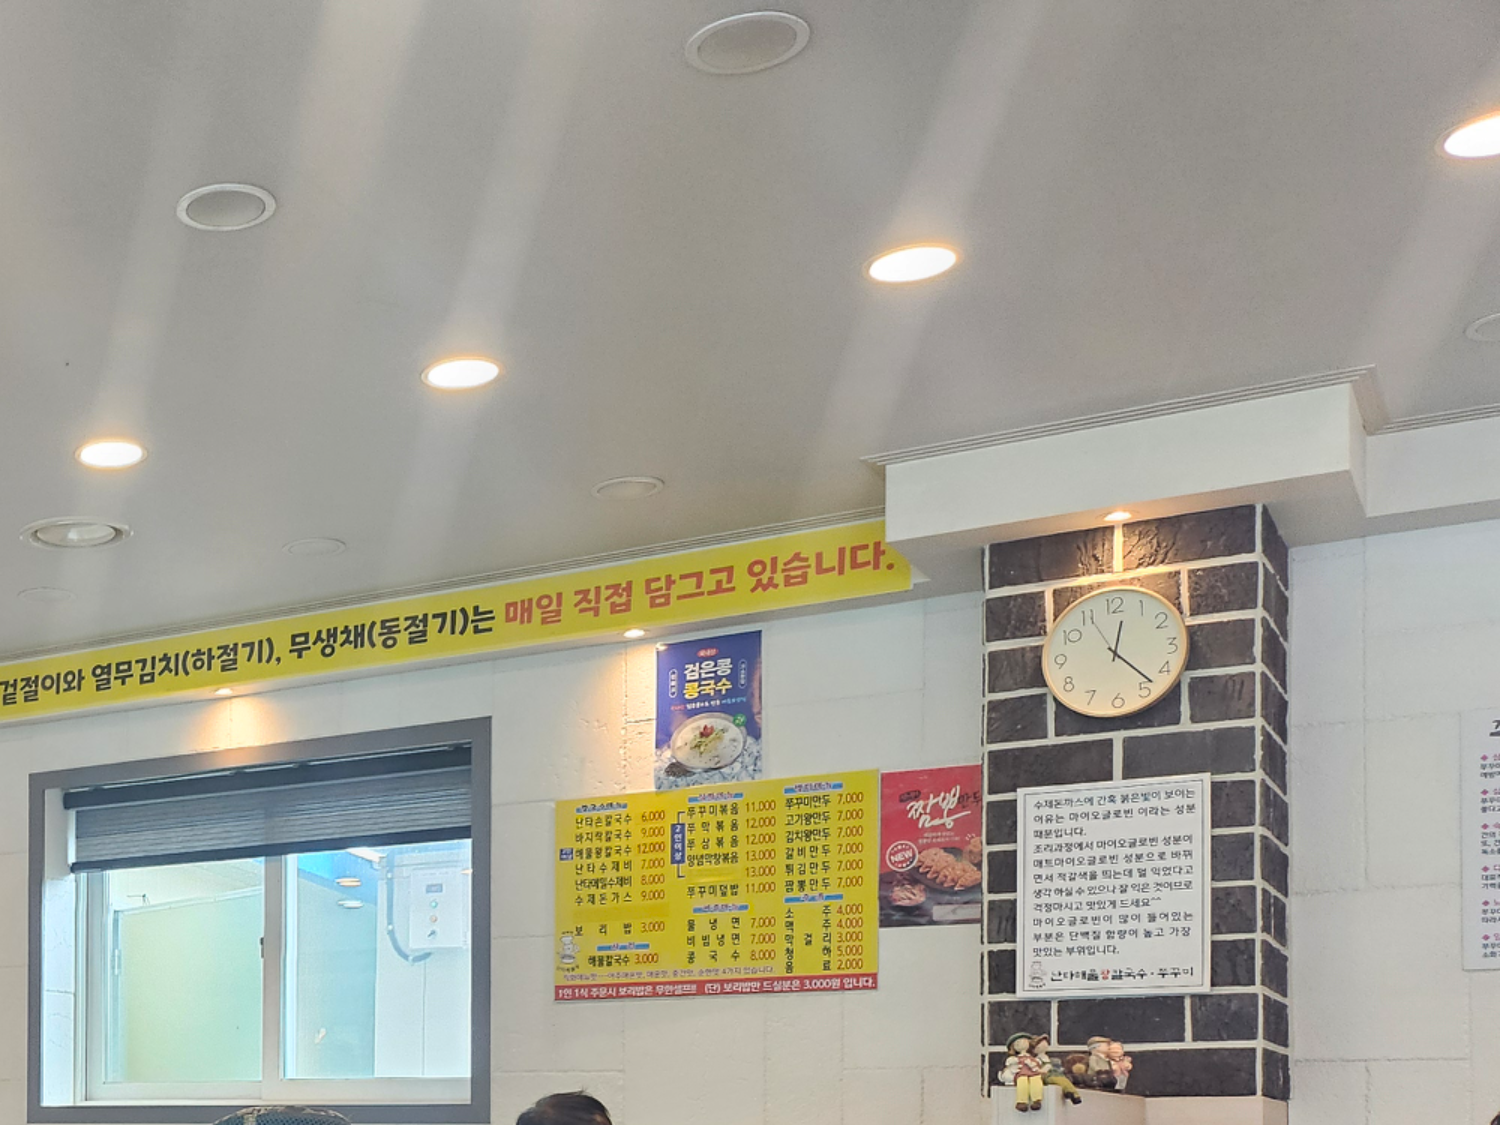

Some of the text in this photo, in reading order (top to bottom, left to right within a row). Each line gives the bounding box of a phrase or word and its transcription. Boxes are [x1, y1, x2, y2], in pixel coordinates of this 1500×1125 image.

[1105, 596, 1125, 615] 12
[90, 636, 282, 692] 열무김치(하절기),
[289, 604, 496, 659] 무생채(동절기)는
[504, 592, 564, 626] 매일
[573, 580, 634, 618] 직접
[643, 565, 736, 609] 담그고
[746, 540, 895, 594] 있습니다.
[1154, 612, 1168, 630] 2
[1062, 628, 1082, 646] 10
[1166, 637, 1178, 654] 3
[684, 658, 733, 681] 검은콩
[1054, 653, 1067, 669] 9
[1158, 660, 1171, 676] 4
[683, 677, 733, 700] 콩국수
[1062, 676, 1075, 692] 8
[1138, 680, 1152, 698] 5
[1085, 689, 1096, 706] 7
[1111, 692, 1125, 709] 6
[890, 849, 913, 864] NEW
